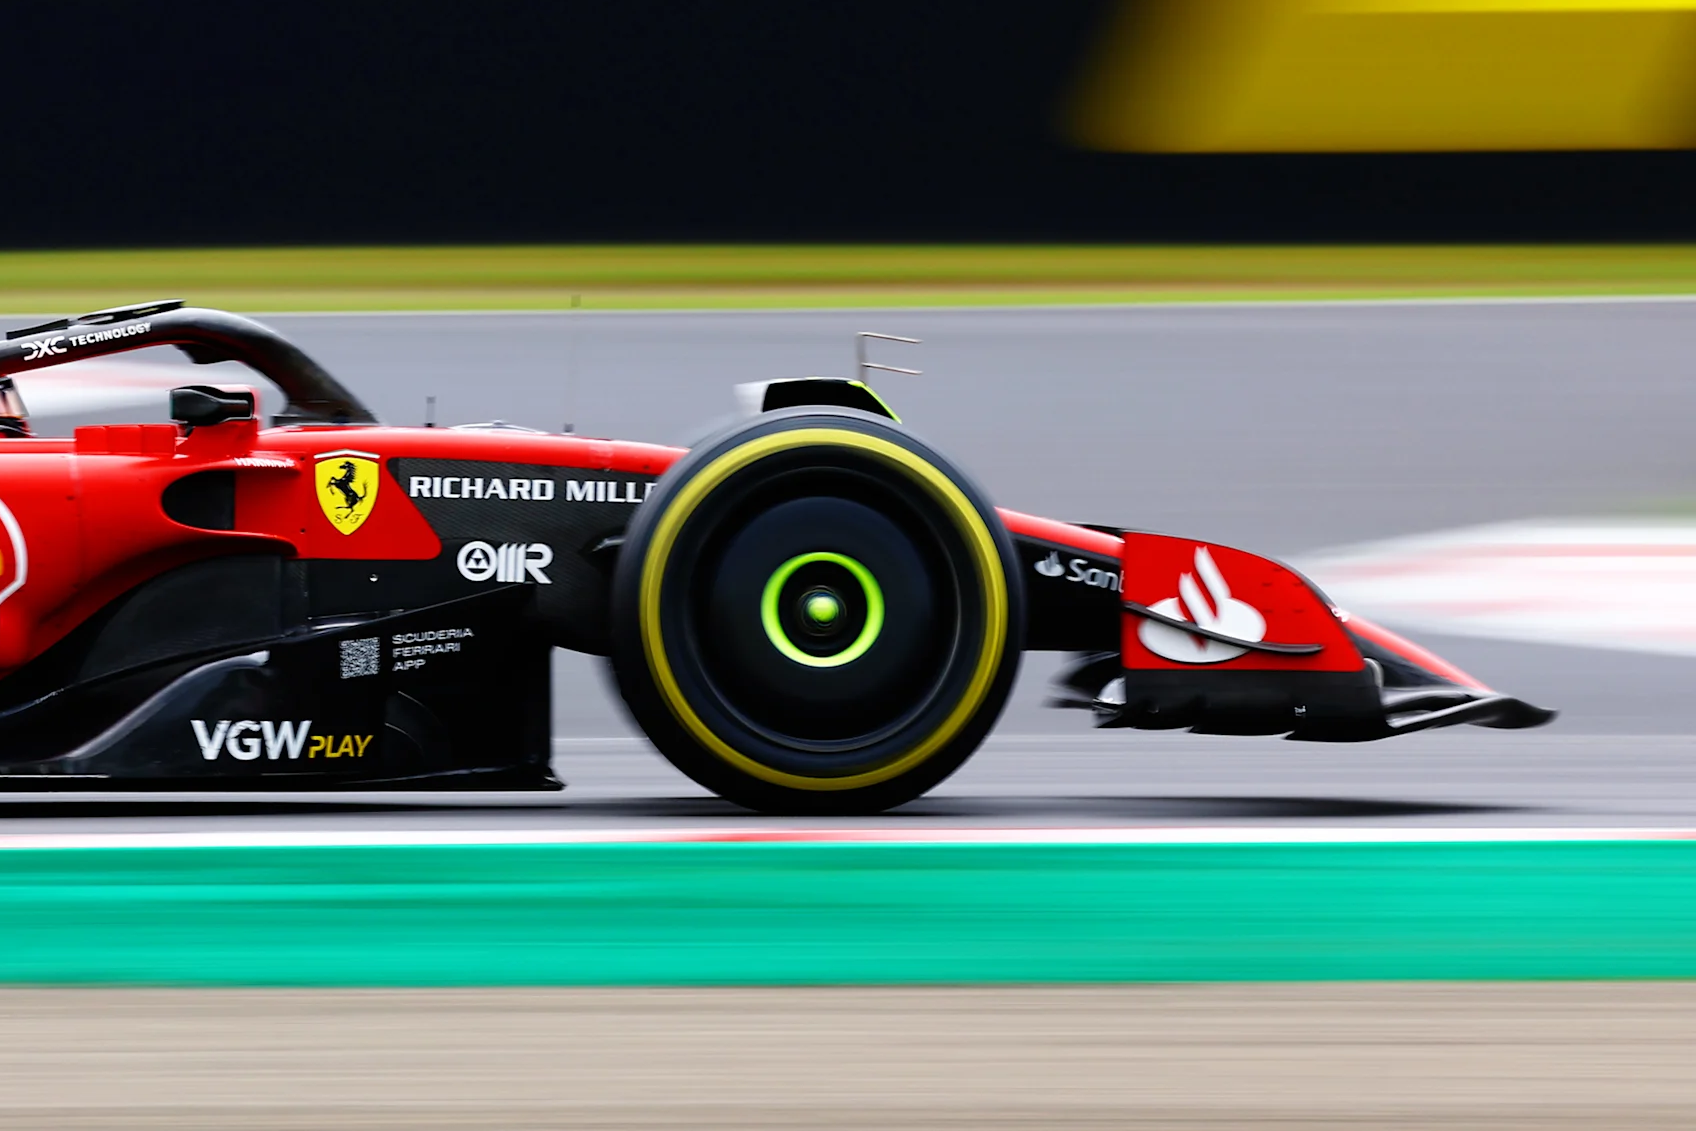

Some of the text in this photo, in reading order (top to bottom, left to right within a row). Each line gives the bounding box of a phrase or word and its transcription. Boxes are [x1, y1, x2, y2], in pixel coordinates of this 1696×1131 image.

[69, 322, 152, 347] TECHNOLOGY
[409, 476, 555, 501] RICHARD
[392, 628, 475, 644] SCUDERIA
[392, 642, 461, 658] FERRARI
[392, 659, 426, 671] APP
[190, 719, 374, 760] VGW PLAY
